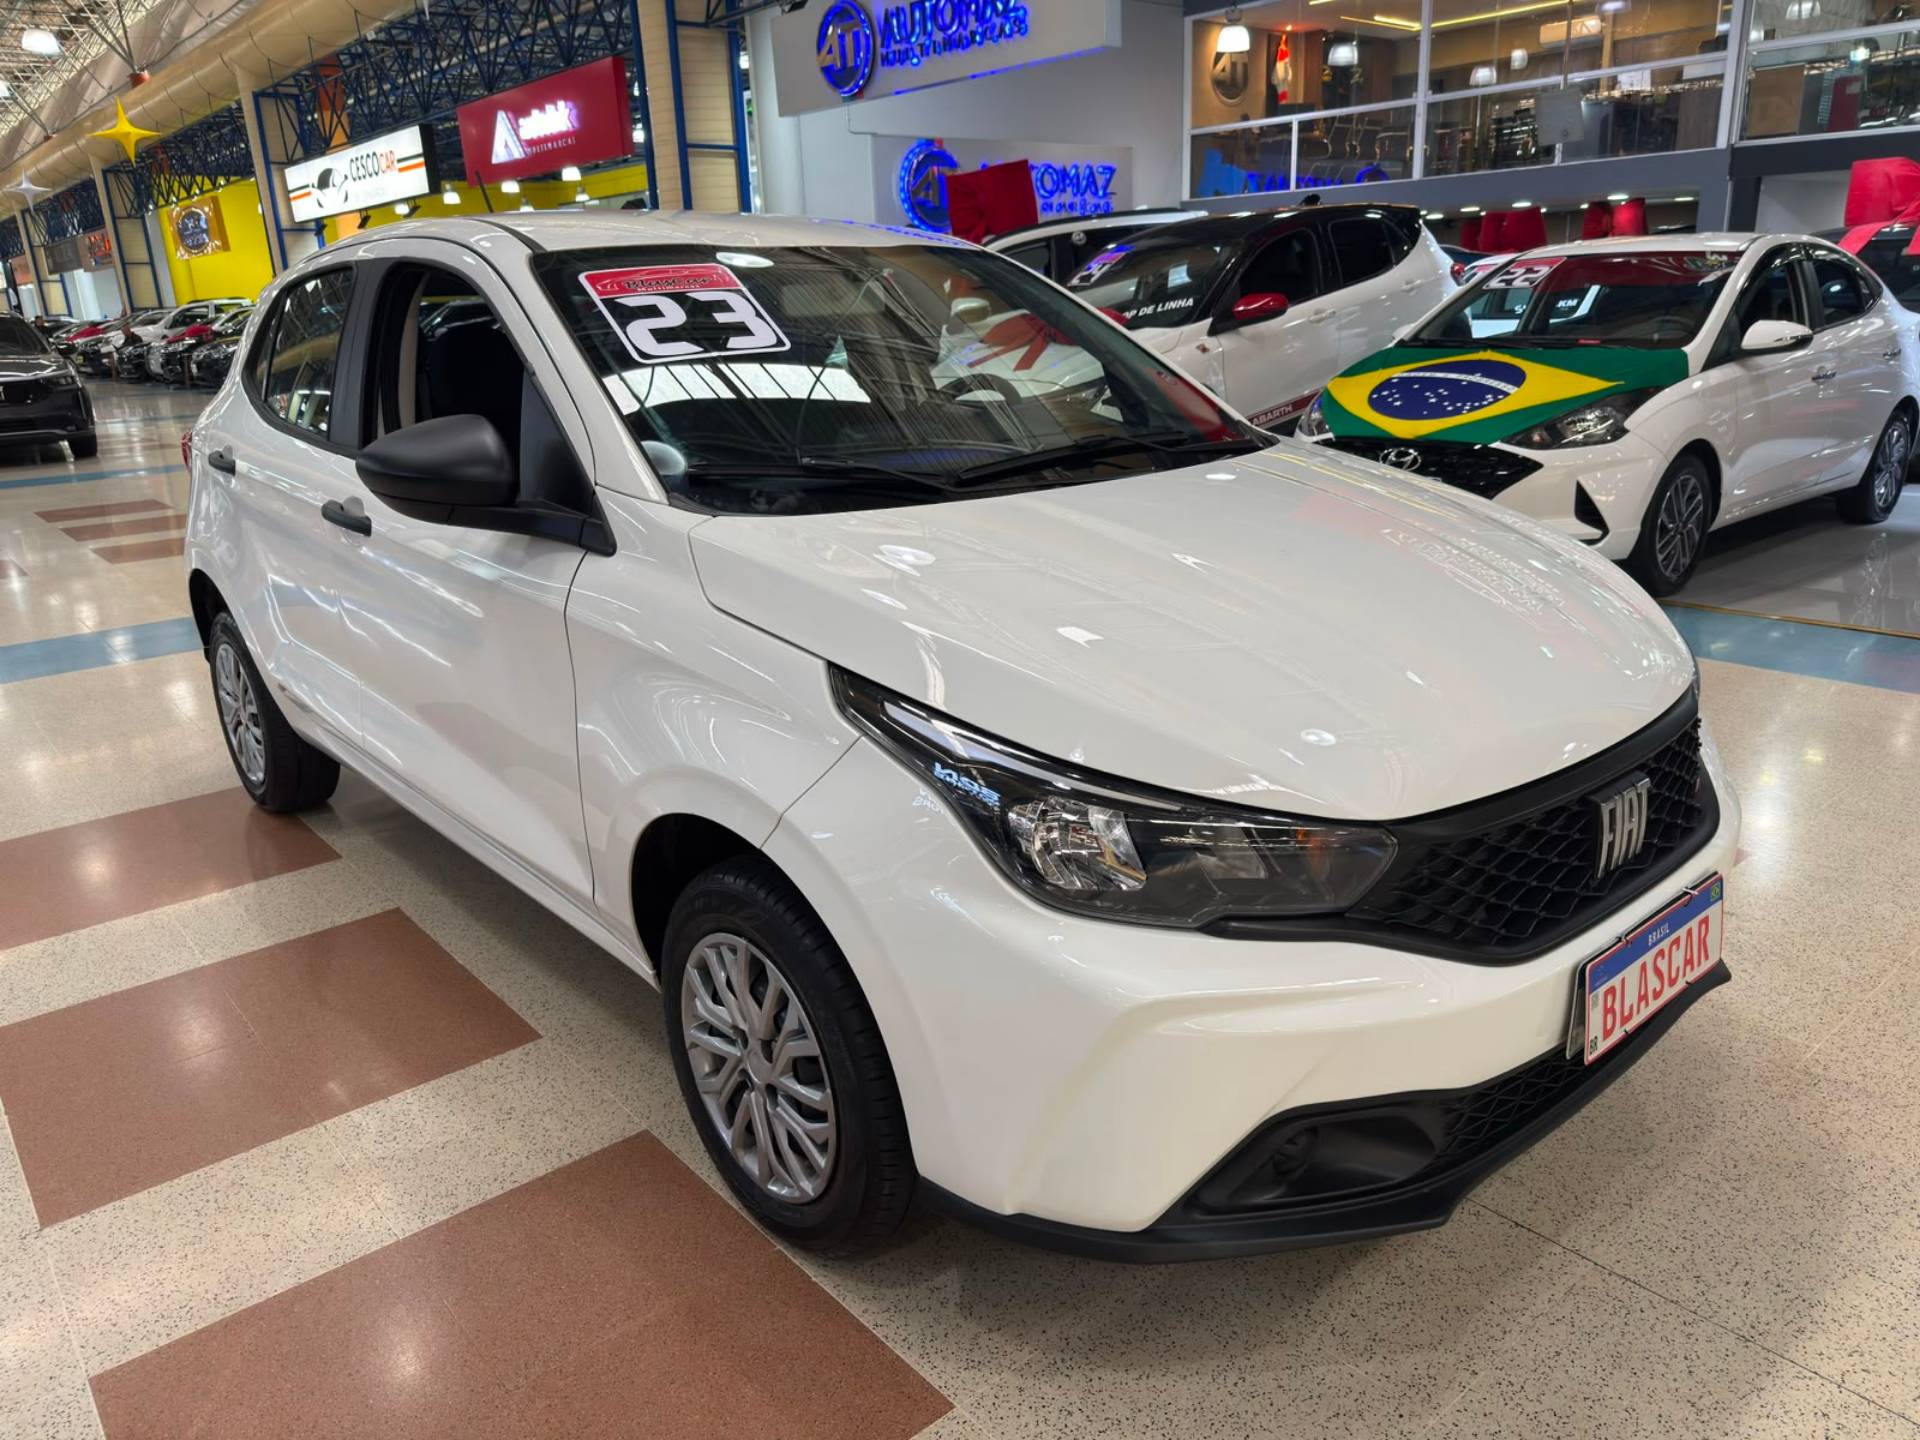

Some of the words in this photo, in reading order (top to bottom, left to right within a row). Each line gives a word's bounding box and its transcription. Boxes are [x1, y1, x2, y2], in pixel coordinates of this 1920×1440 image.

[1488, 266, 1550, 287] 22
[1138, 304, 1156, 317] DE
[1156, 297, 1194, 312] LINHA
[614, 291, 777, 356] 23
[1253, 403, 1293, 425] ABARTH
[1597, 777, 1650, 879] FIAT
[1648, 922, 1670, 947] BRASIL
[1602, 914, 1710, 1041] BLASCAR
